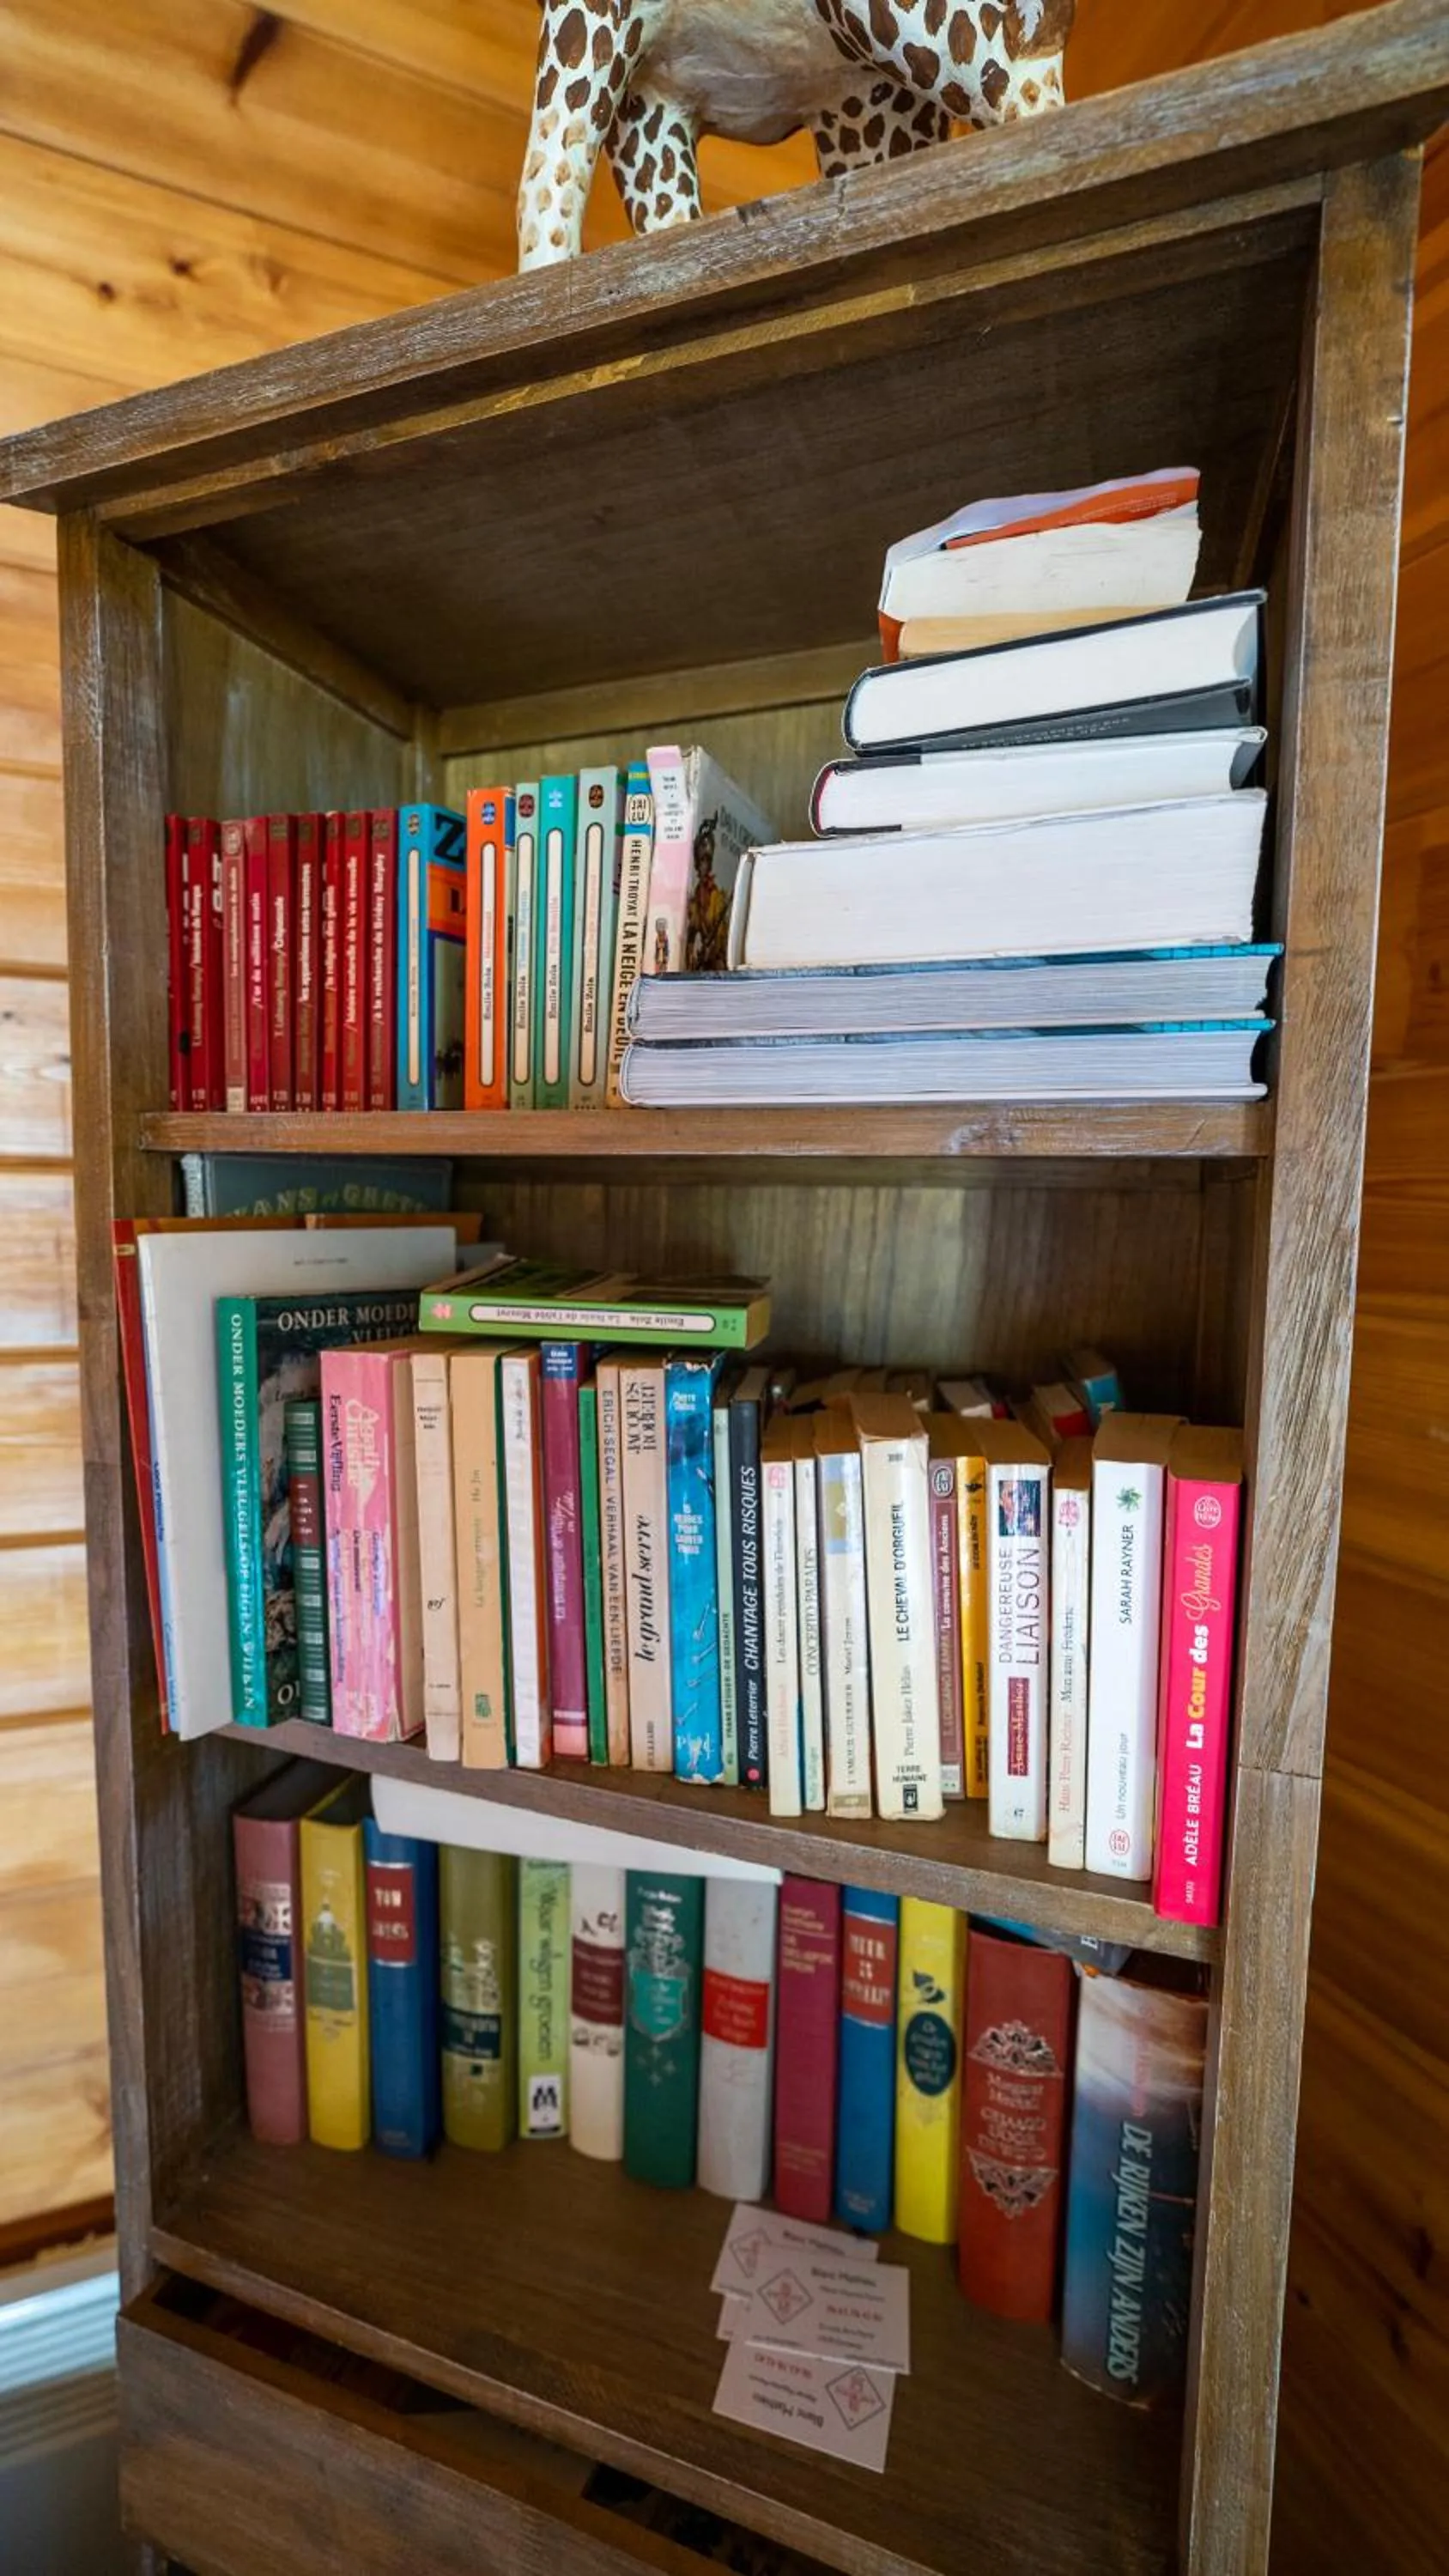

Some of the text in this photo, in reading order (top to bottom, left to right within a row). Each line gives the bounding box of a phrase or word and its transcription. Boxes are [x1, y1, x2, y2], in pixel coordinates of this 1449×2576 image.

[628, 840, 642, 876] HENRI
[626, 878, 640, 917] TROYAT
[621, 922, 639, 941] LA
[517, 976, 526, 996] Zola
[549, 965, 558, 987] Zola
[585, 977, 595, 999] Zola
[619, 944, 637, 988] NEIGE
[277, 1307, 349, 1332] ONDER
[231, 1314, 245, 1375] ONDER
[233, 1382, 246, 1461] MOEDERS
[330, 1395, 343, 1440] Eerste
[235, 1467, 249, 1549] VLEUGELS
[603, 1390, 621, 1673] ERICH SEGAL VERHAAL VAN EEN LIEFDE
[890, 1502, 906, 1570] D'ORGUEIL
[938, 1515, 950, 1552] Anciens
[939, 1556, 950, 1574] des
[1119, 1525, 1135, 1624] SARAH RAYNER
[1180, 1545, 1221, 1621] Grandes
[239, 1583, 252, 1633] EIGEN
[632, 1574, 660, 1643] grand
[741, 1467, 758, 1760] Pierre Leterrier CHANTAGE TOUS RISQUES
[894, 1577, 909, 1622] CHEVAL
[997, 1547, 1014, 1663] DANGEREUSE
[1015, 1546, 1040, 1666] LIAISON
[805, 1606, 819, 1675] CONCERTO
[896, 1626, 910, 1642] LE
[1189, 1625, 1209, 1663] des
[241, 1641, 255, 1709] WIEKEN
[1187, 1668, 1207, 1719] Cour
[1185, 1724, 1205, 1750] La
[1117, 1759, 1128, 1801] nouveau
[1185, 1765, 1203, 1814] BRÉAU
[1116, 1805, 1127, 1820] Un
[1182, 1820, 1200, 1866] ADÈLE
[538, 1888, 558, 1931] Waar
[529, 1995, 555, 2061] groeien
[1121, 2121, 1154, 2159] DE
[1108, 2157, 1150, 2238] RIJKEN
[1110, 2236, 1146, 2292] ZIJN
[1107, 2293, 1143, 2385] ANDERS
[797, 2408, 824, 2429] Blanc
